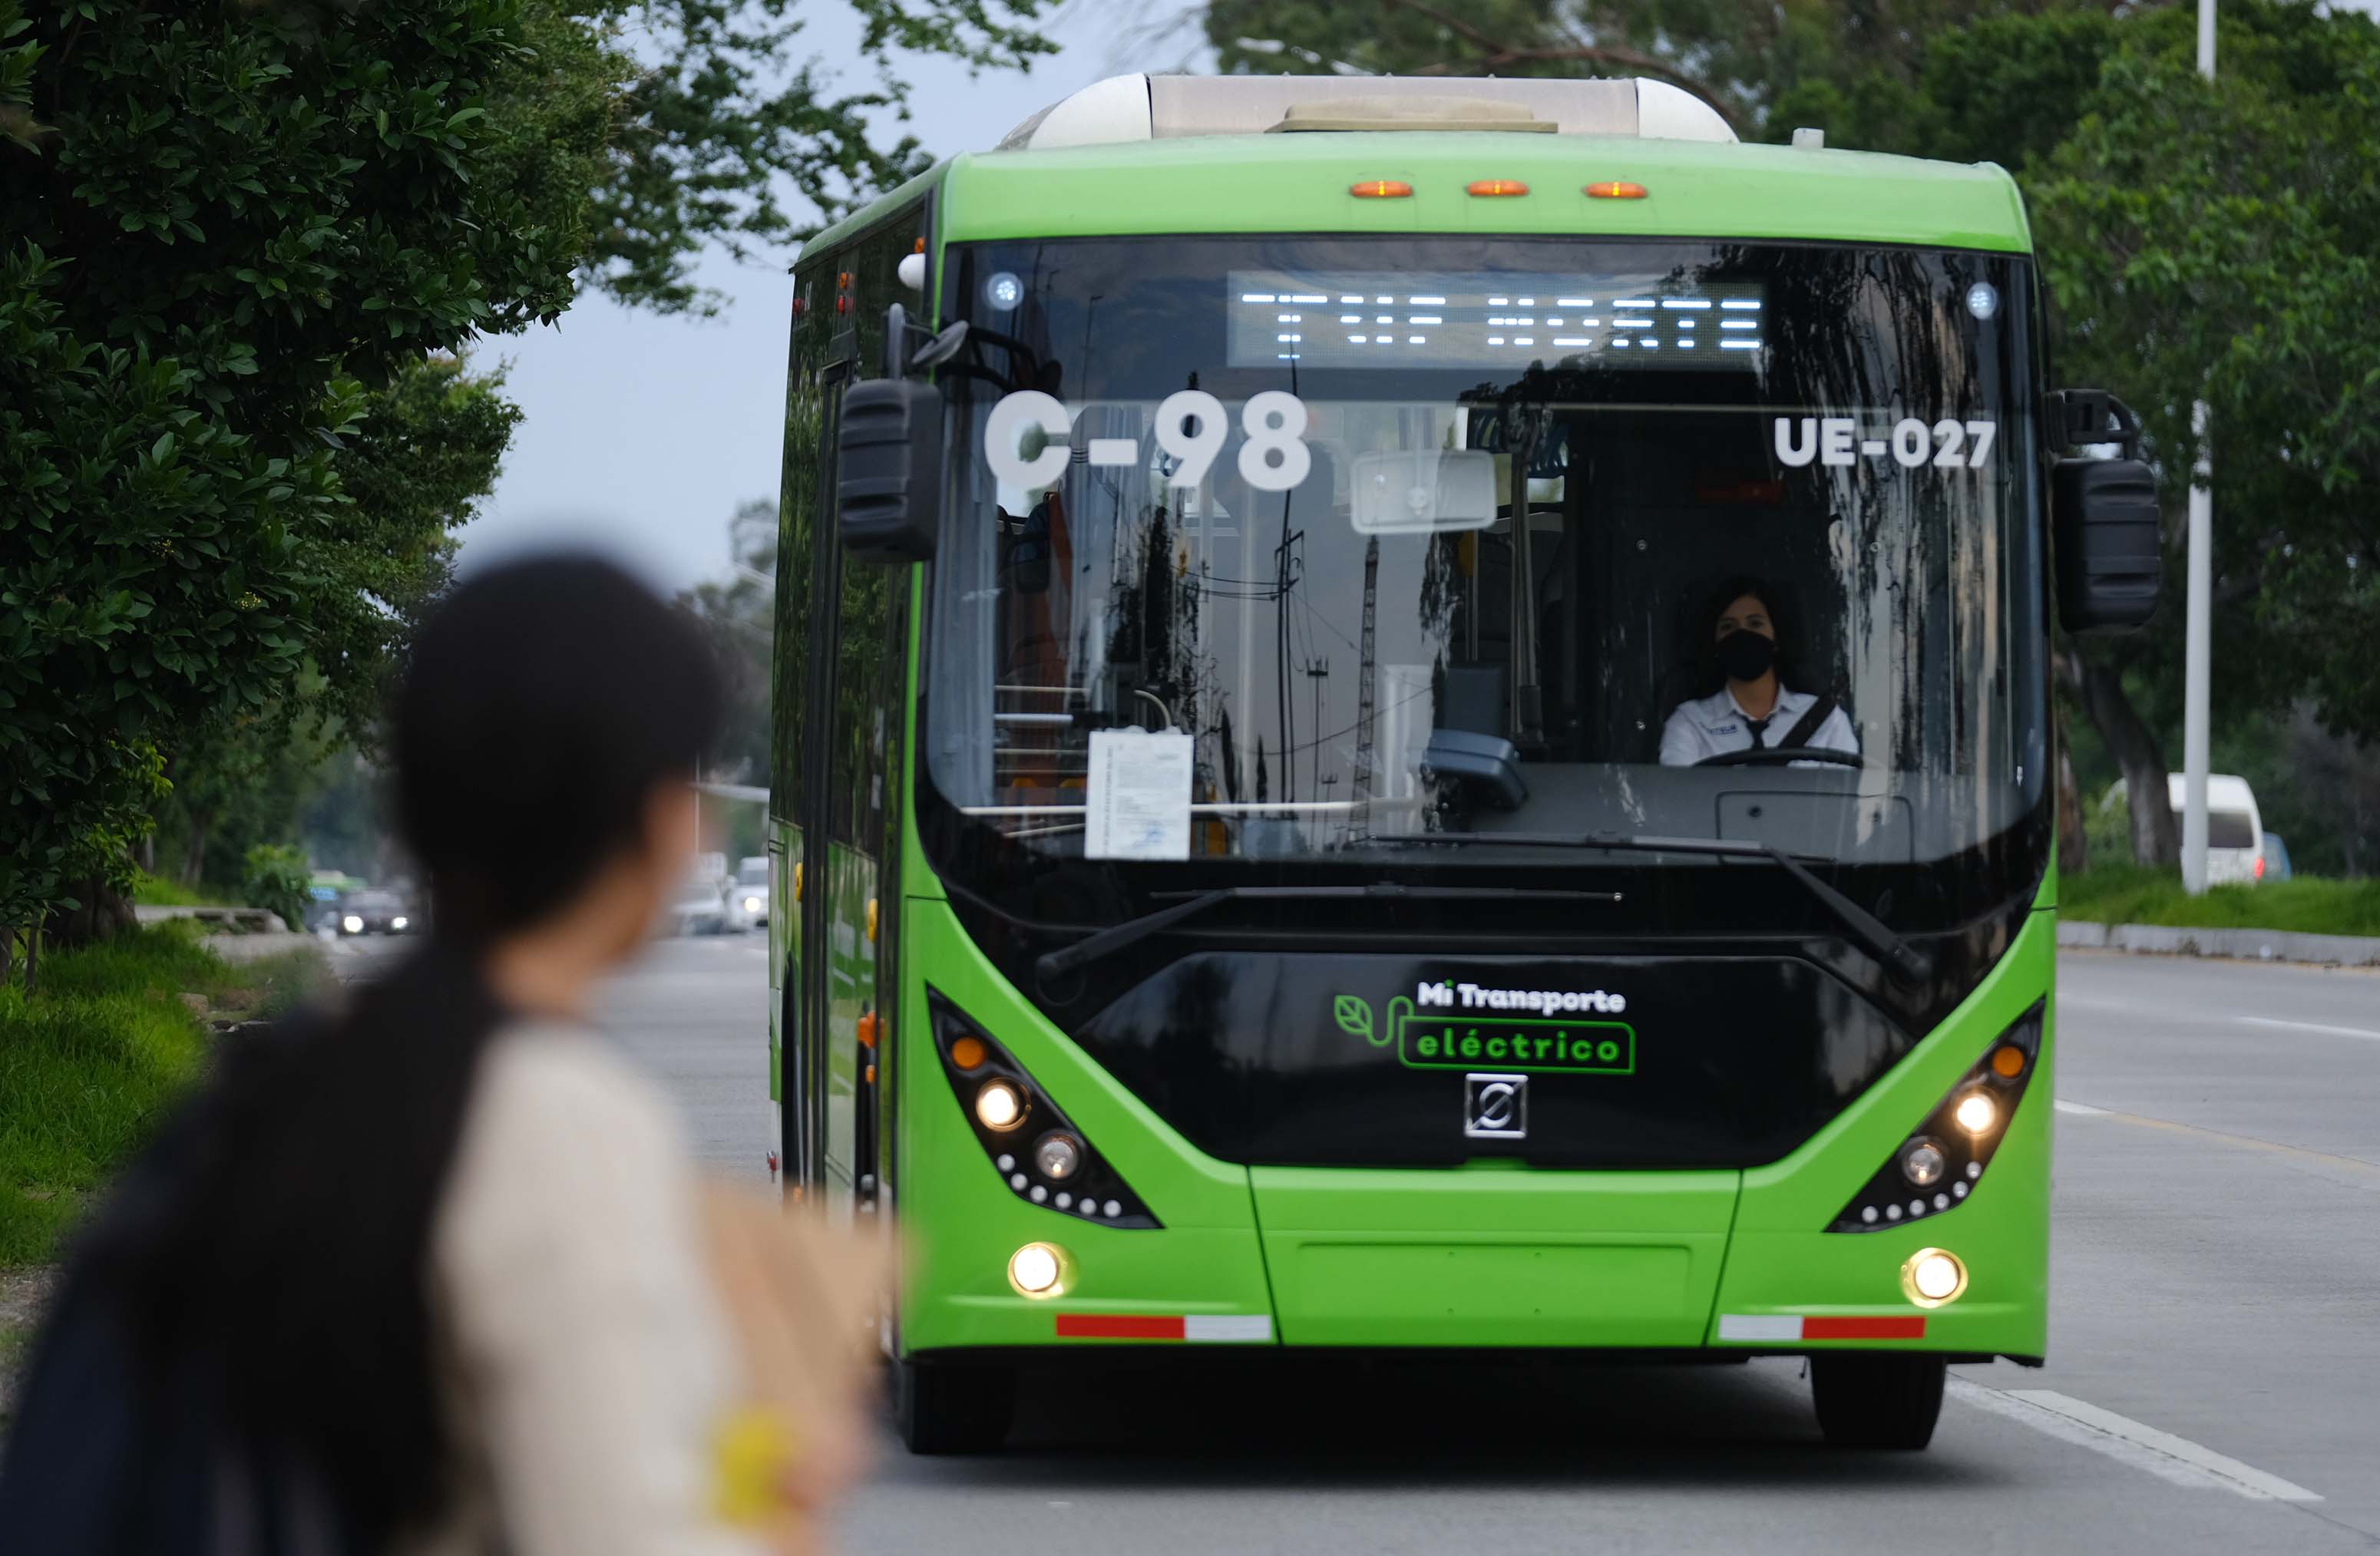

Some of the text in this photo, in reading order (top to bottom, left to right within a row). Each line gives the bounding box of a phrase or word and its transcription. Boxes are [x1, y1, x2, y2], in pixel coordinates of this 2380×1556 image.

[984, 390, 1311, 491] C-98
[1774, 417, 1996, 468] UE-027
[1417, 979, 1626, 1016] Mi Transporte
[1416, 1027, 1621, 1063] eléctrico
